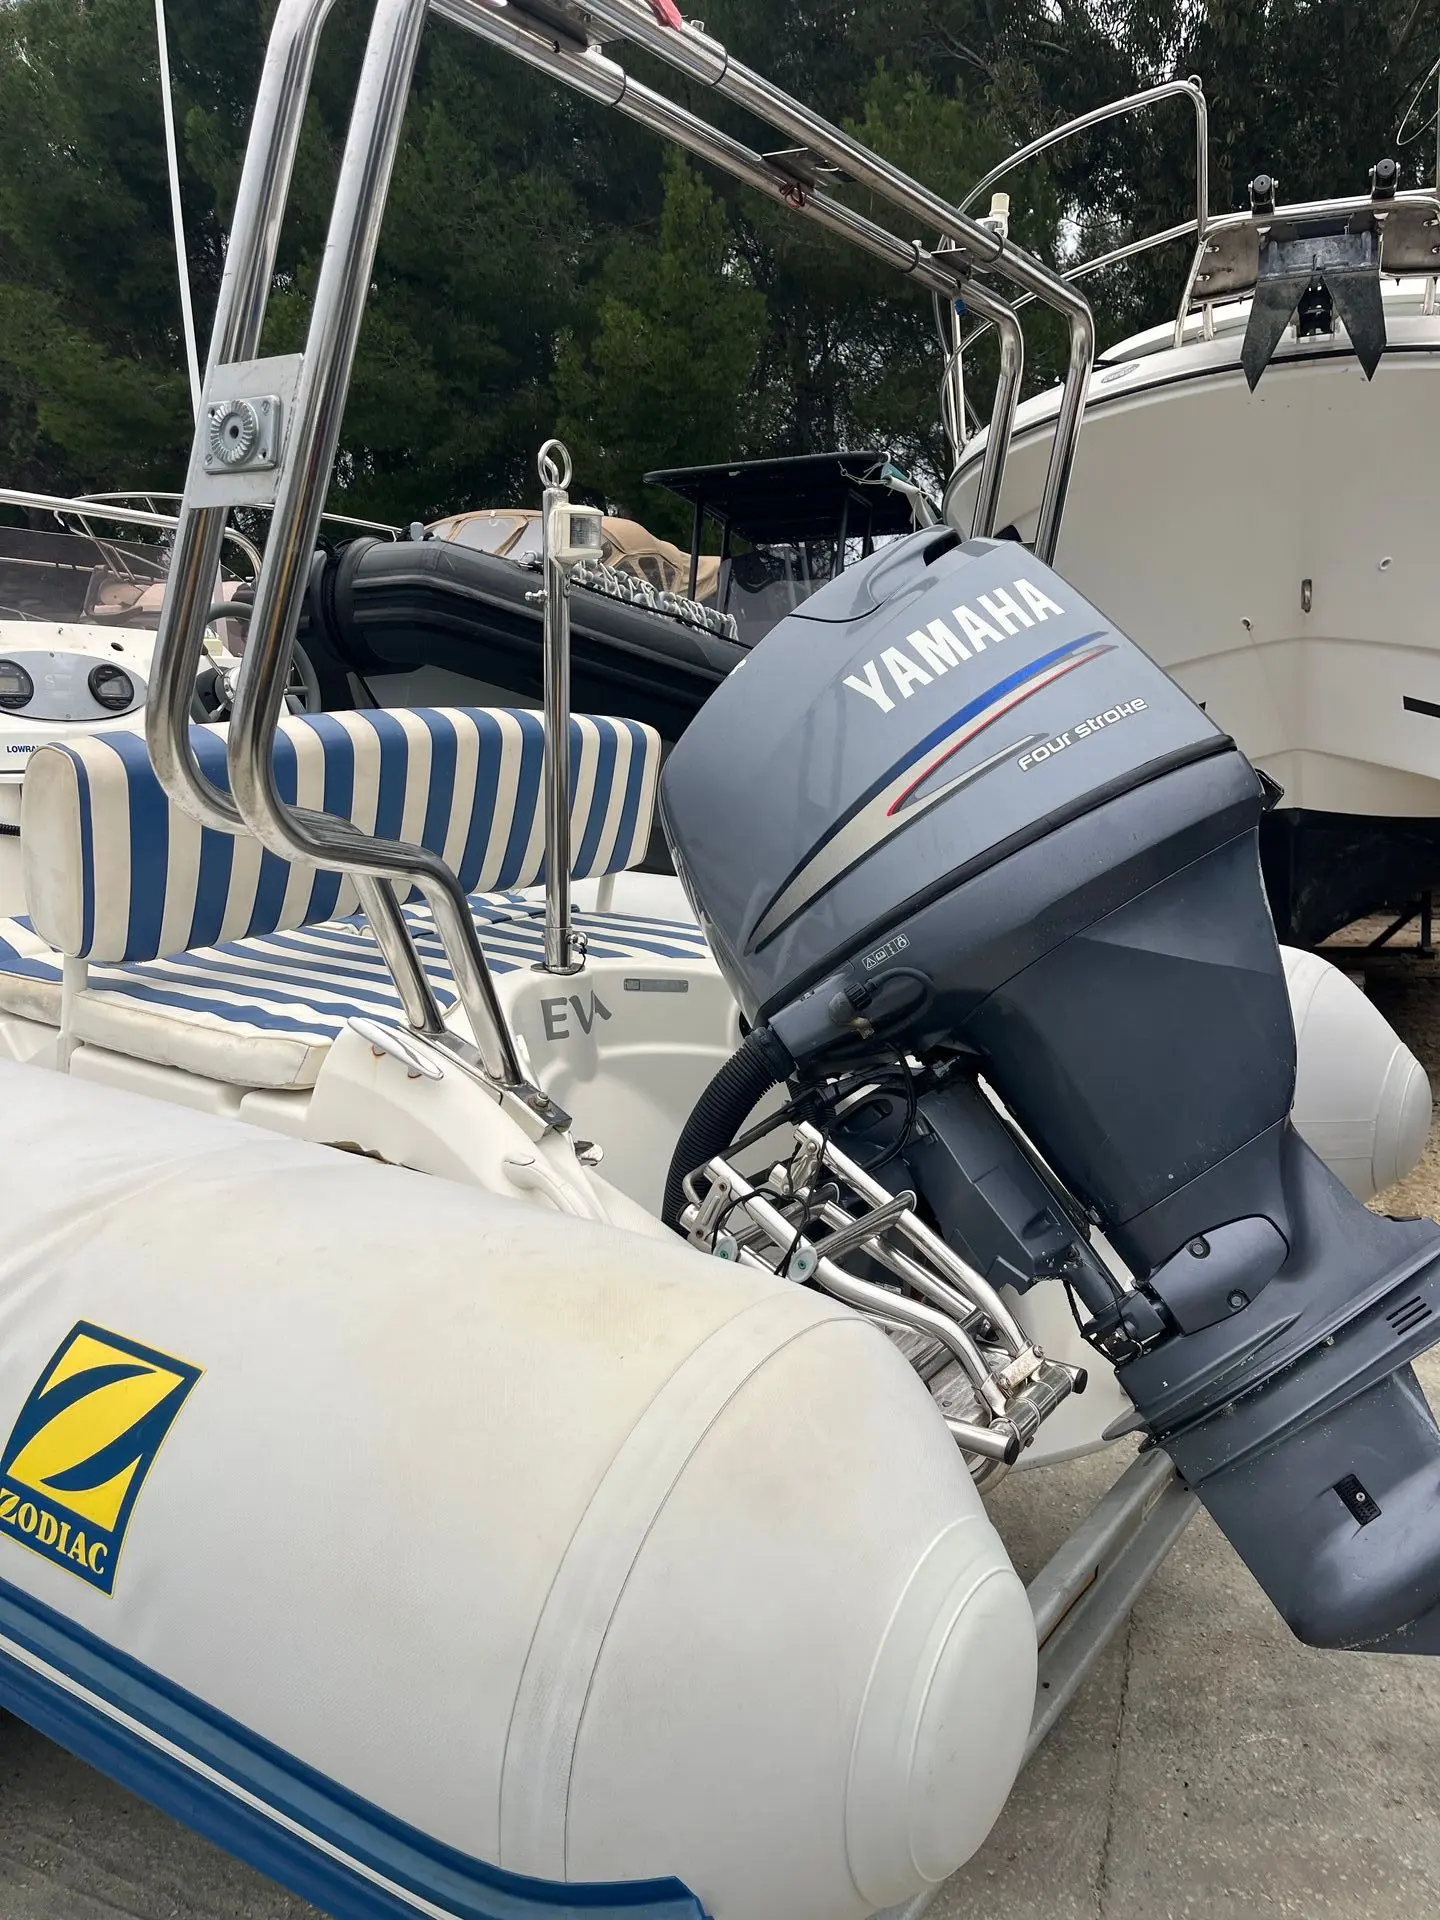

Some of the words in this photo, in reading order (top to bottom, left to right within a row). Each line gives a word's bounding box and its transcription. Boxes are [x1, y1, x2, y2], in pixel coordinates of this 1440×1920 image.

[842, 578, 1065, 713] YAMAHA
[6, 745, 38, 753] LOWRA
[0, 1487, 108, 1575] ZODIAC
